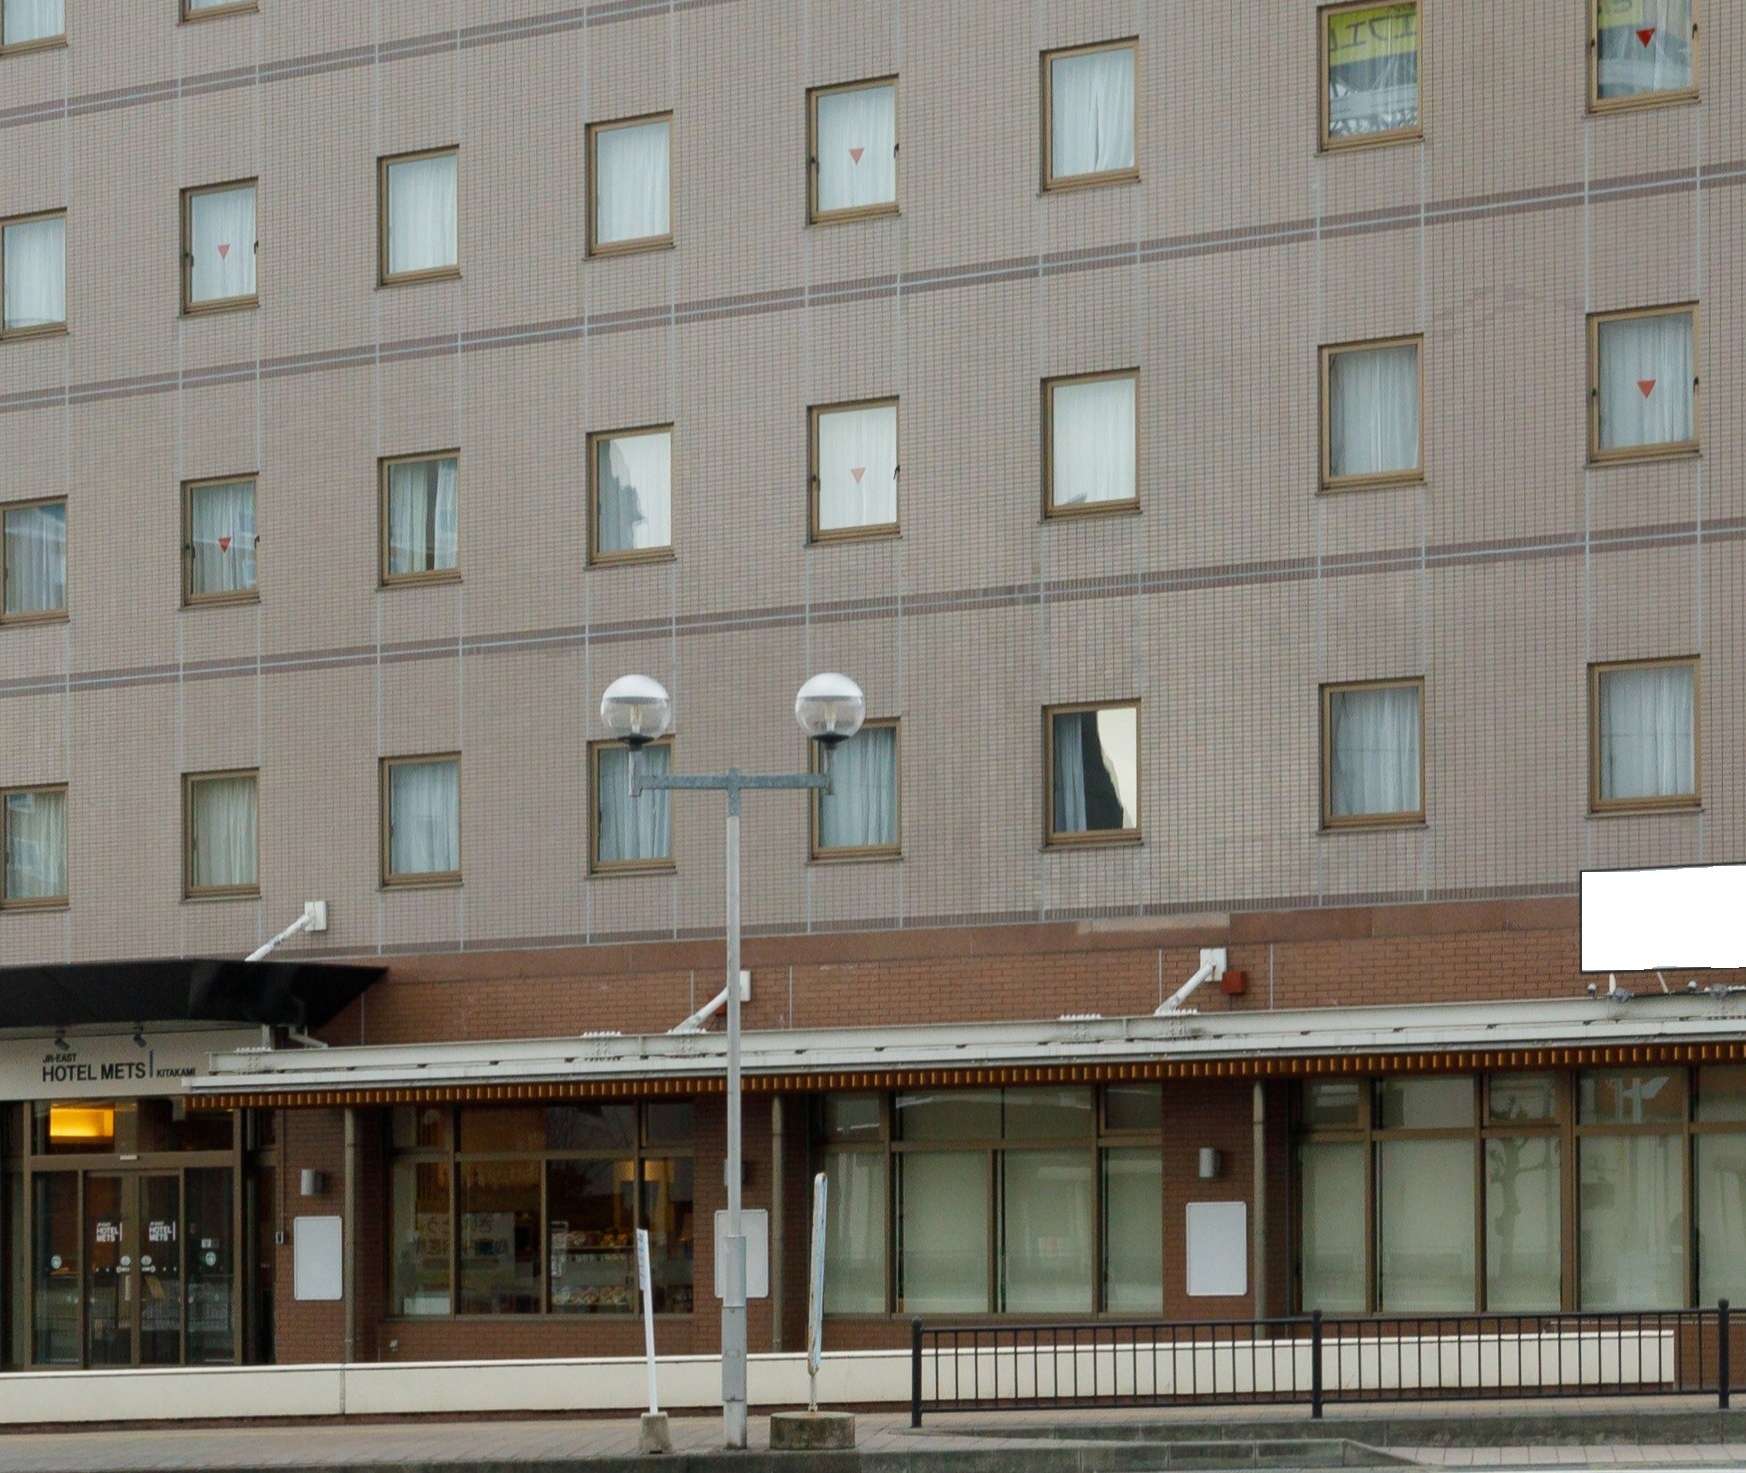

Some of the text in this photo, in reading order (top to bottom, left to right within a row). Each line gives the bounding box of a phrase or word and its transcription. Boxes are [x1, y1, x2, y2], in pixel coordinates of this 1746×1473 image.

[42, 1062, 146, 1082] HOTEL METS
[156, 1067, 196, 1078] KITAKAMI
